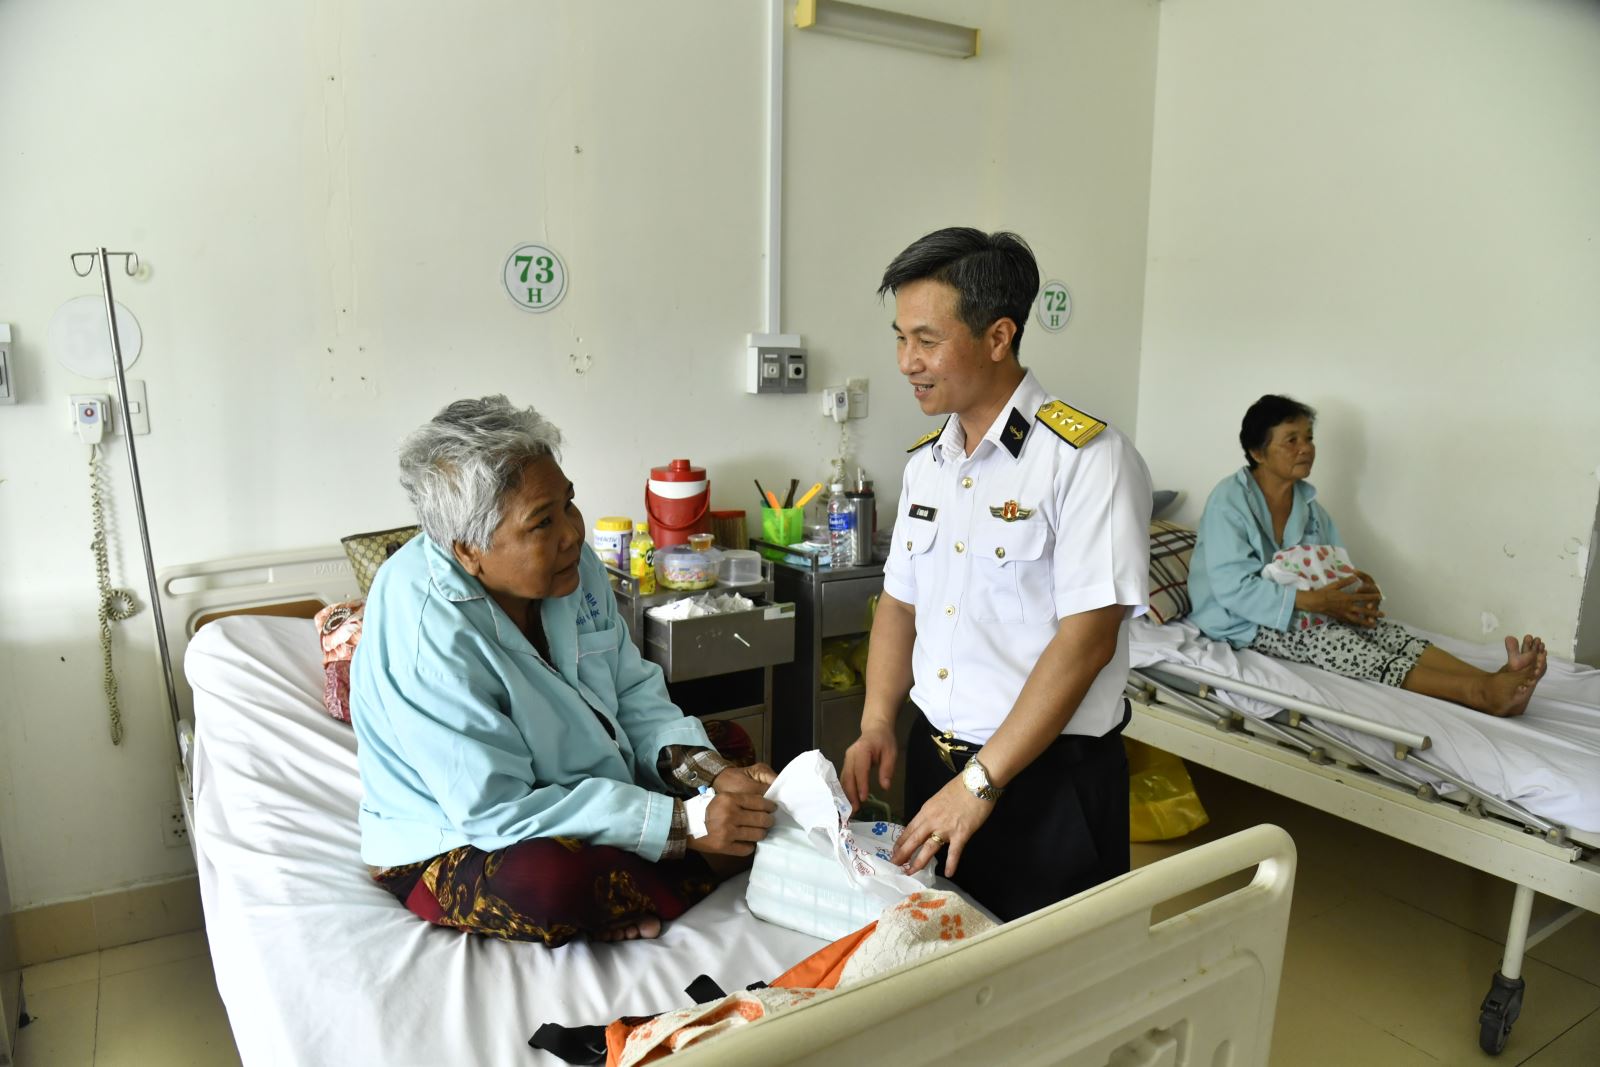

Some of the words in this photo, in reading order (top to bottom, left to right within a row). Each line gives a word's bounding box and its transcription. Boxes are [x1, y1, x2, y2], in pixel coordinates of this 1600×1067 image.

[515, 255, 554, 284] 73
[527, 287, 543, 303] H
[1044, 290, 1067, 311] 72
[1050, 314, 1059, 327] H
